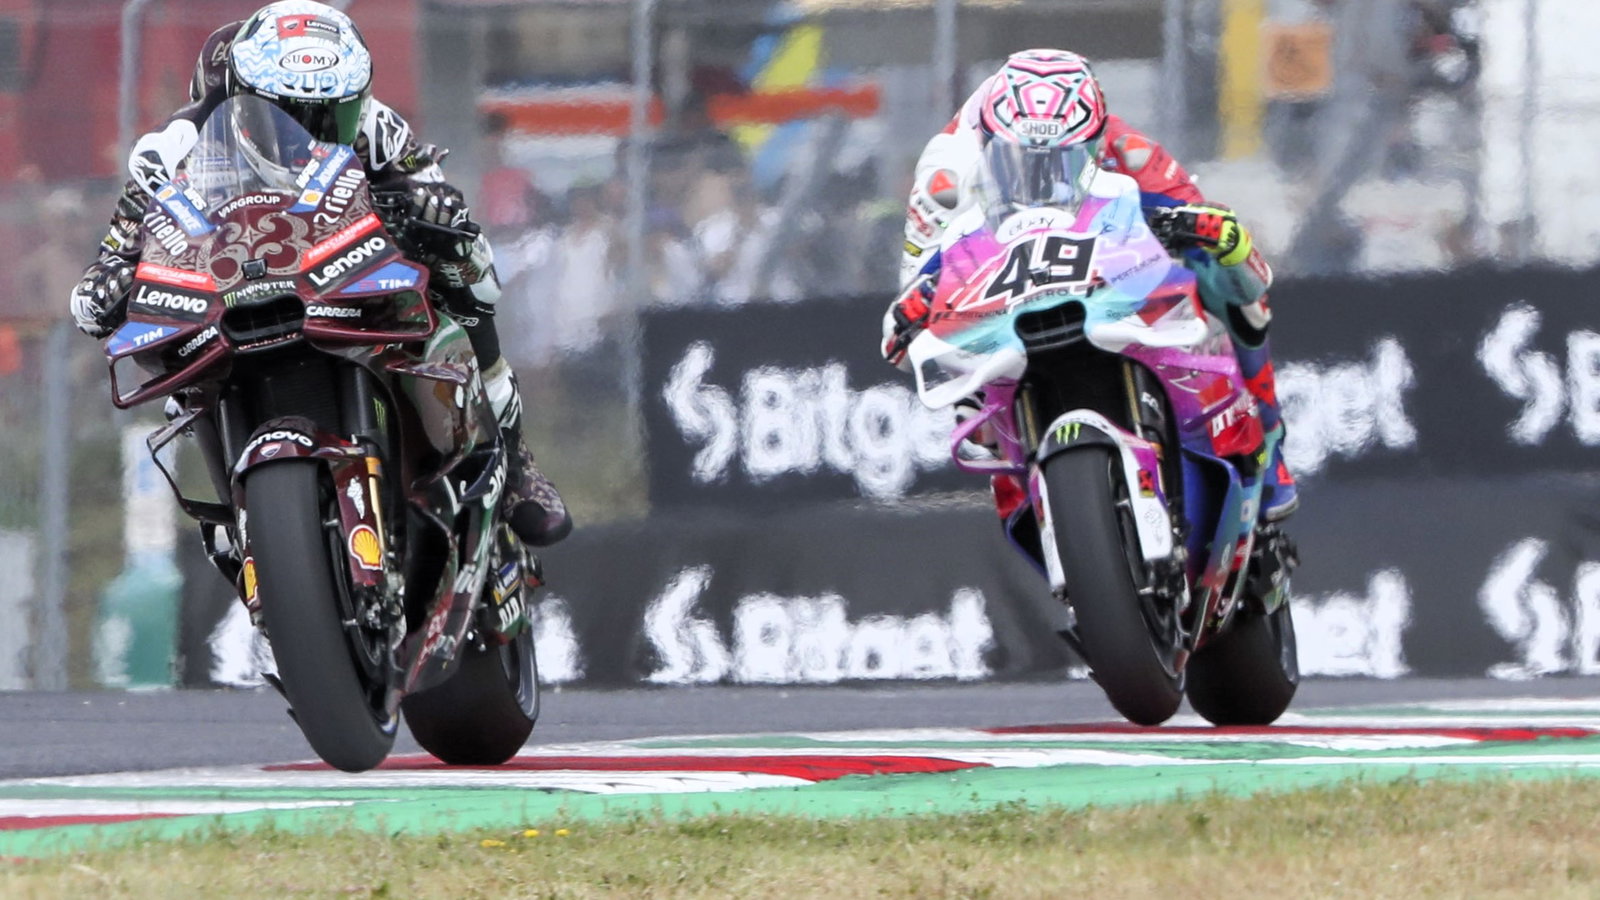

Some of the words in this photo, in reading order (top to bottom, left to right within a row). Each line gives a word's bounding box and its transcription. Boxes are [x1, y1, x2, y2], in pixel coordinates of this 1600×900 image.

[306, 20, 338, 32] Lenovo
[284, 54, 335, 68] SUOMY
[1021, 121, 1058, 136] SHOEI
[217, 195, 281, 218] VARGROUP
[146, 214, 189, 256] riello
[308, 236, 387, 287] Lenovo
[983, 235, 1097, 300] 49
[236, 280, 296, 299] MONSTER
[378, 279, 413, 290] TIM
[135, 285, 208, 314] Lenovo
[305, 305, 362, 318] CARRERA
[133, 327, 164, 347] TIM
[178, 325, 219, 357] CARRERA
[740, 360, 956, 502] Bitge
